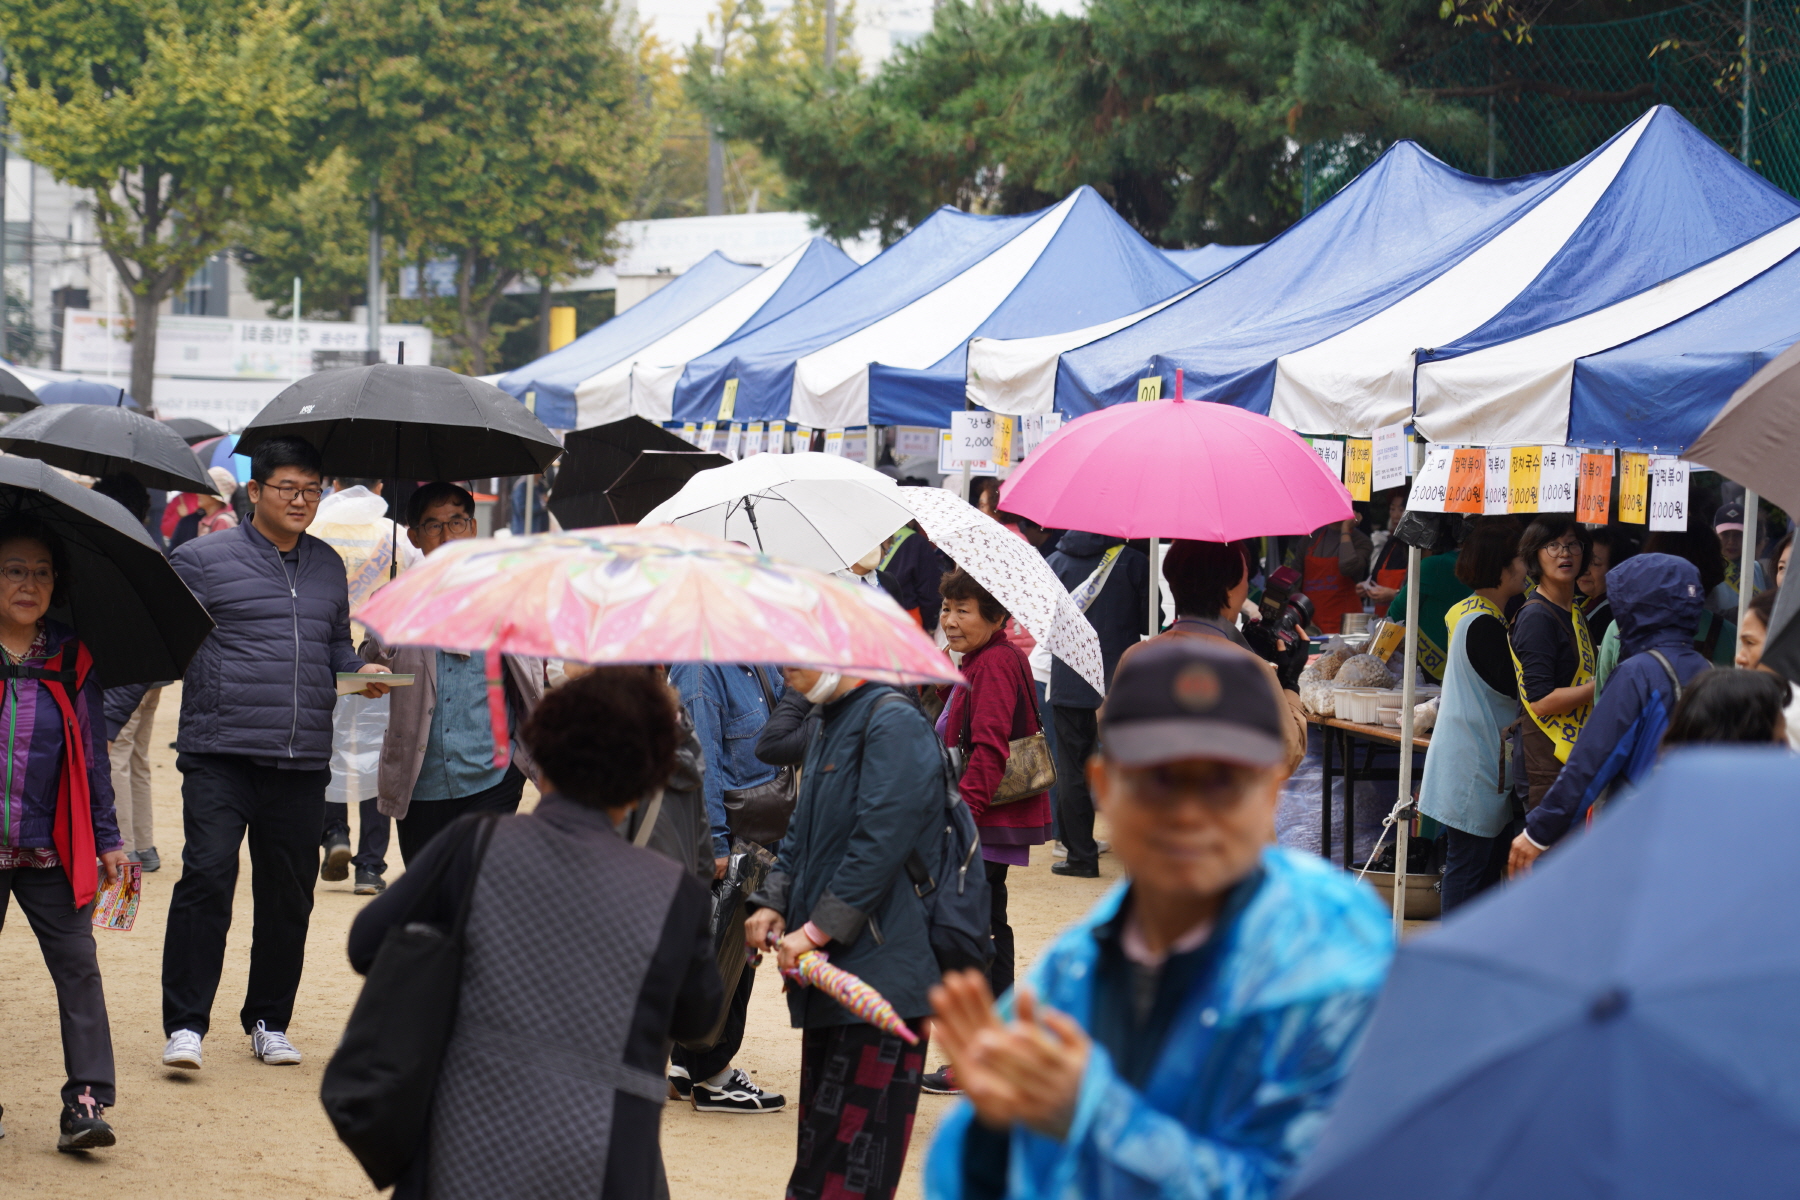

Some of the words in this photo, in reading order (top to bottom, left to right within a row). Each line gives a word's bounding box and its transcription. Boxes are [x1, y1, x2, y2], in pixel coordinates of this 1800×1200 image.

[967, 417, 997, 429] 강냉
[1512, 454, 1540, 474] 잔치국수
[1543, 452, 1557, 470] 어묵
[1411, 485, 1447, 503] 5,000원
[1448, 486, 1482, 504] 2,000원
[1509, 486, 1539, 506] 5,000원
[1542, 482, 1572, 504] 1,000원
[1652, 500, 1684, 520] 2,000원
